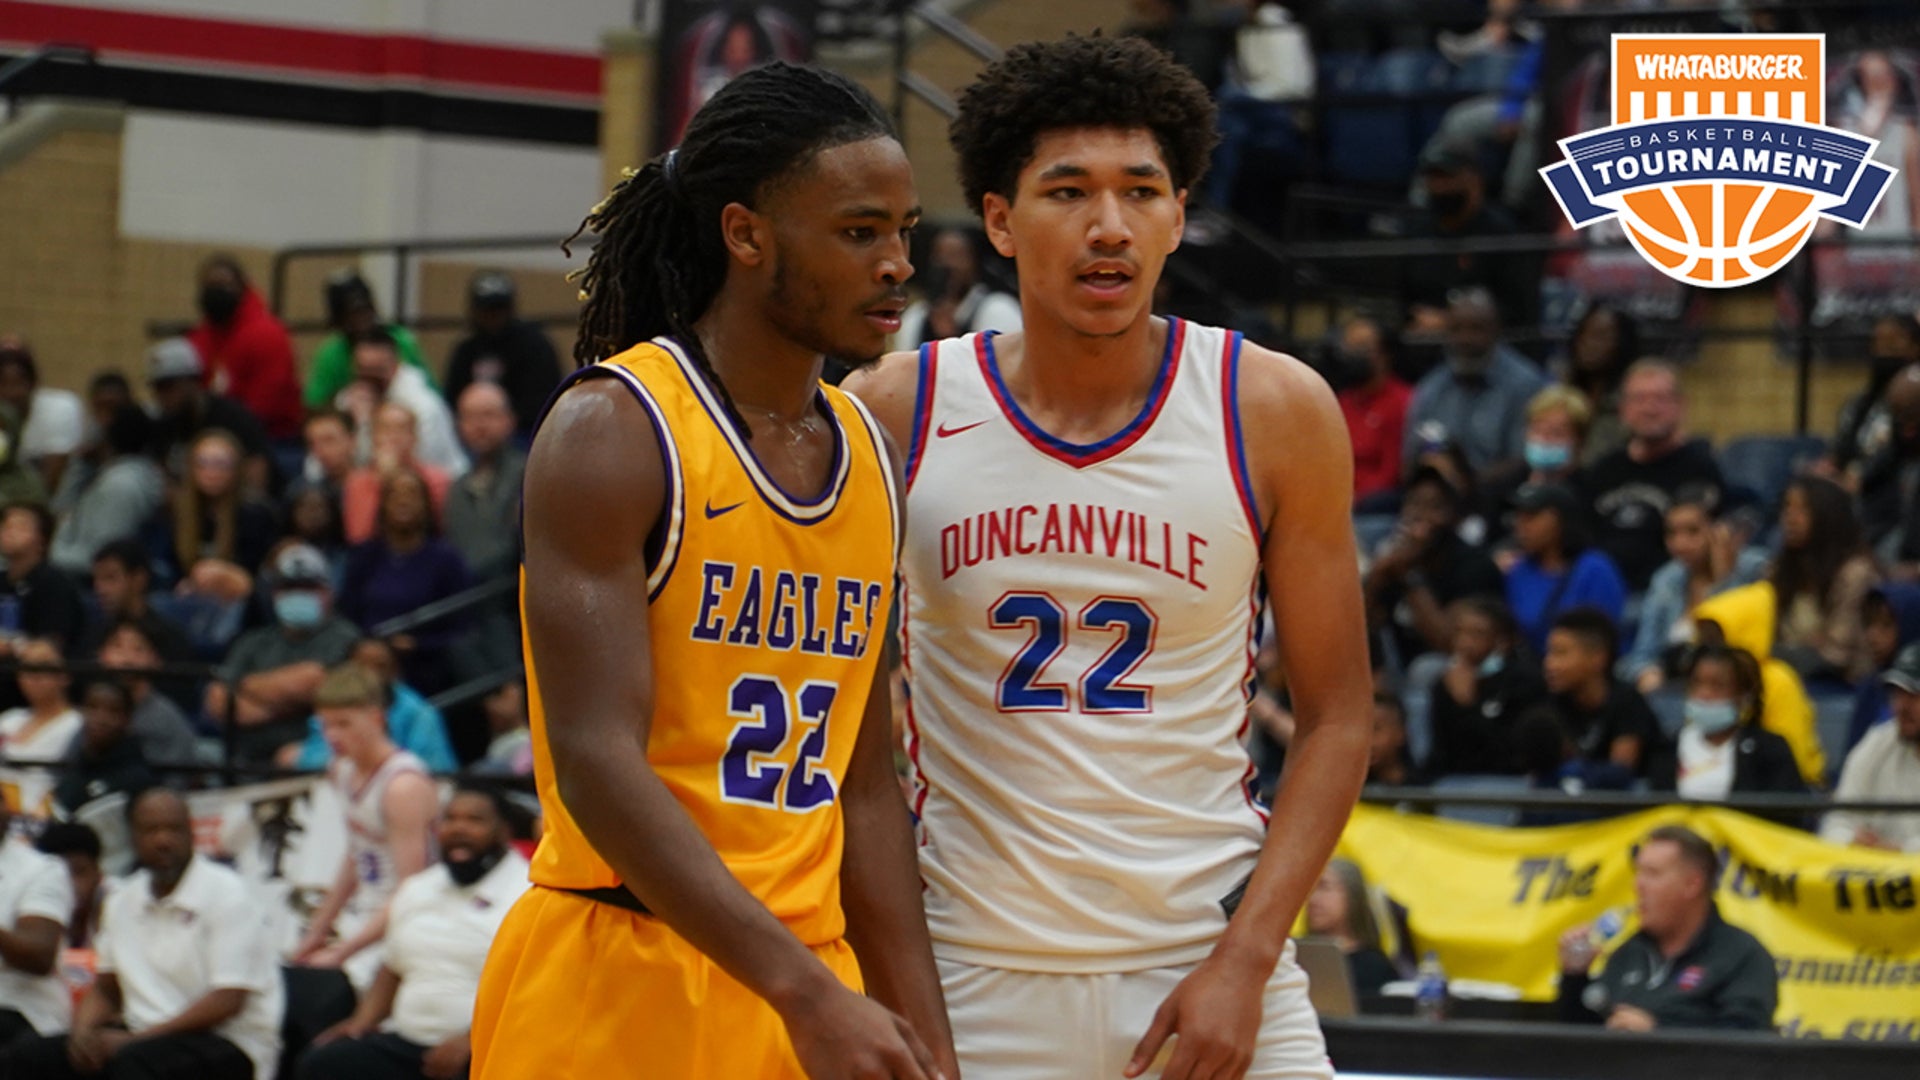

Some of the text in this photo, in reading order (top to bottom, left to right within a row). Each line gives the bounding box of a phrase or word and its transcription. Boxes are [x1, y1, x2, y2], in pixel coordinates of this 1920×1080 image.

[941, 503, 1208, 591] DUNCANVILLE
[690, 560, 882, 659] EAGLES
[987, 590, 1159, 714] 22
[718, 673, 839, 815] 22
[1512, 857, 1600, 904] The
